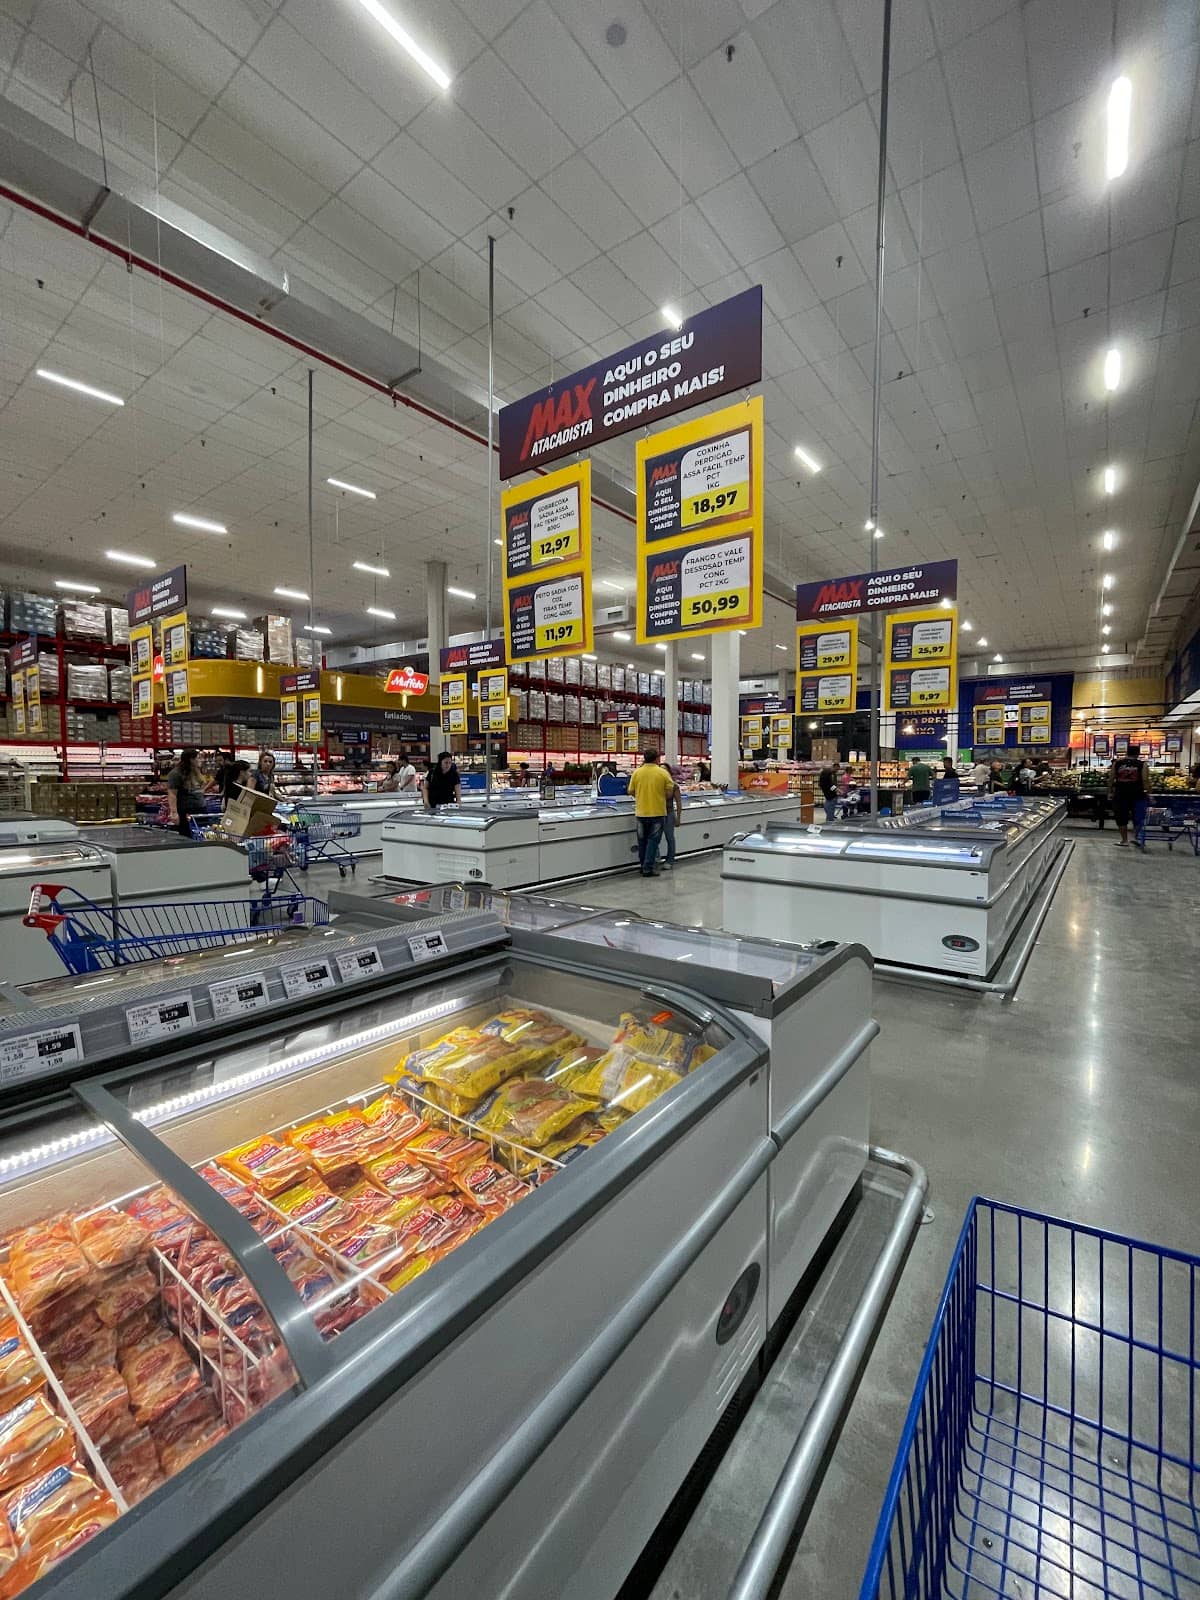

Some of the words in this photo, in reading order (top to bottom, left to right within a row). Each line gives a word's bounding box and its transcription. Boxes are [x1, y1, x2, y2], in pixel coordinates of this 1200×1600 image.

[602, 358, 642, 386] AQUI
[644, 350, 658, 367] O
[659, 332, 695, 361] SEU
[602, 361, 683, 408] DINHEIRO
[602, 388, 672, 427] COMPRA
[674, 365, 726, 400] MAIS!
[519, 376, 598, 461] MAX
[530, 418, 594, 457] ATACADISTA
[696, 441, 730, 457] COXINHA
[649, 462, 679, 488] MAX
[683, 469, 701, 480] ASSA
[702, 462, 723, 474] FACIL
[724, 454, 745, 466] TEMP
[706, 472, 721, 481] PCT
[655, 487, 672, 498] AQUI
[707, 481, 720, 490] 1KG
[660, 495, 674, 505] SEU
[692, 490, 738, 515] 18,97
[647, 502, 680, 517] DINHEIRO
[649, 511, 678, 524] COMPRA
[540, 536, 570, 555] 12,97
[686, 553, 716, 566] FRANGO
[723, 546, 744, 558] VALE
[724, 556, 745, 566] TEMP
[650, 560, 679, 584] MAX
[703, 570, 726, 580] CONG
[867, 575, 892, 587] AQUI
[893, 574, 901, 582] O
[902, 570, 922, 580] SEU
[655, 585, 673, 595] AQUI
[699, 581, 714, 589] PCT
[867, 582, 915, 596] DINHEIRO
[661, 593, 674, 602] SEU
[812, 580, 863, 612] MAX
[867, 594, 909, 606] COMPRA
[909, 589, 939, 601] MAIS!
[648, 600, 680, 612] DINHEIRO
[691, 594, 739, 616] 50,99
[819, 599, 861, 612] ATACADISTA
[650, 609, 679, 620] COMPRA
[545, 625, 573, 641] 11,97
[918, 646, 944, 654] 25,97
